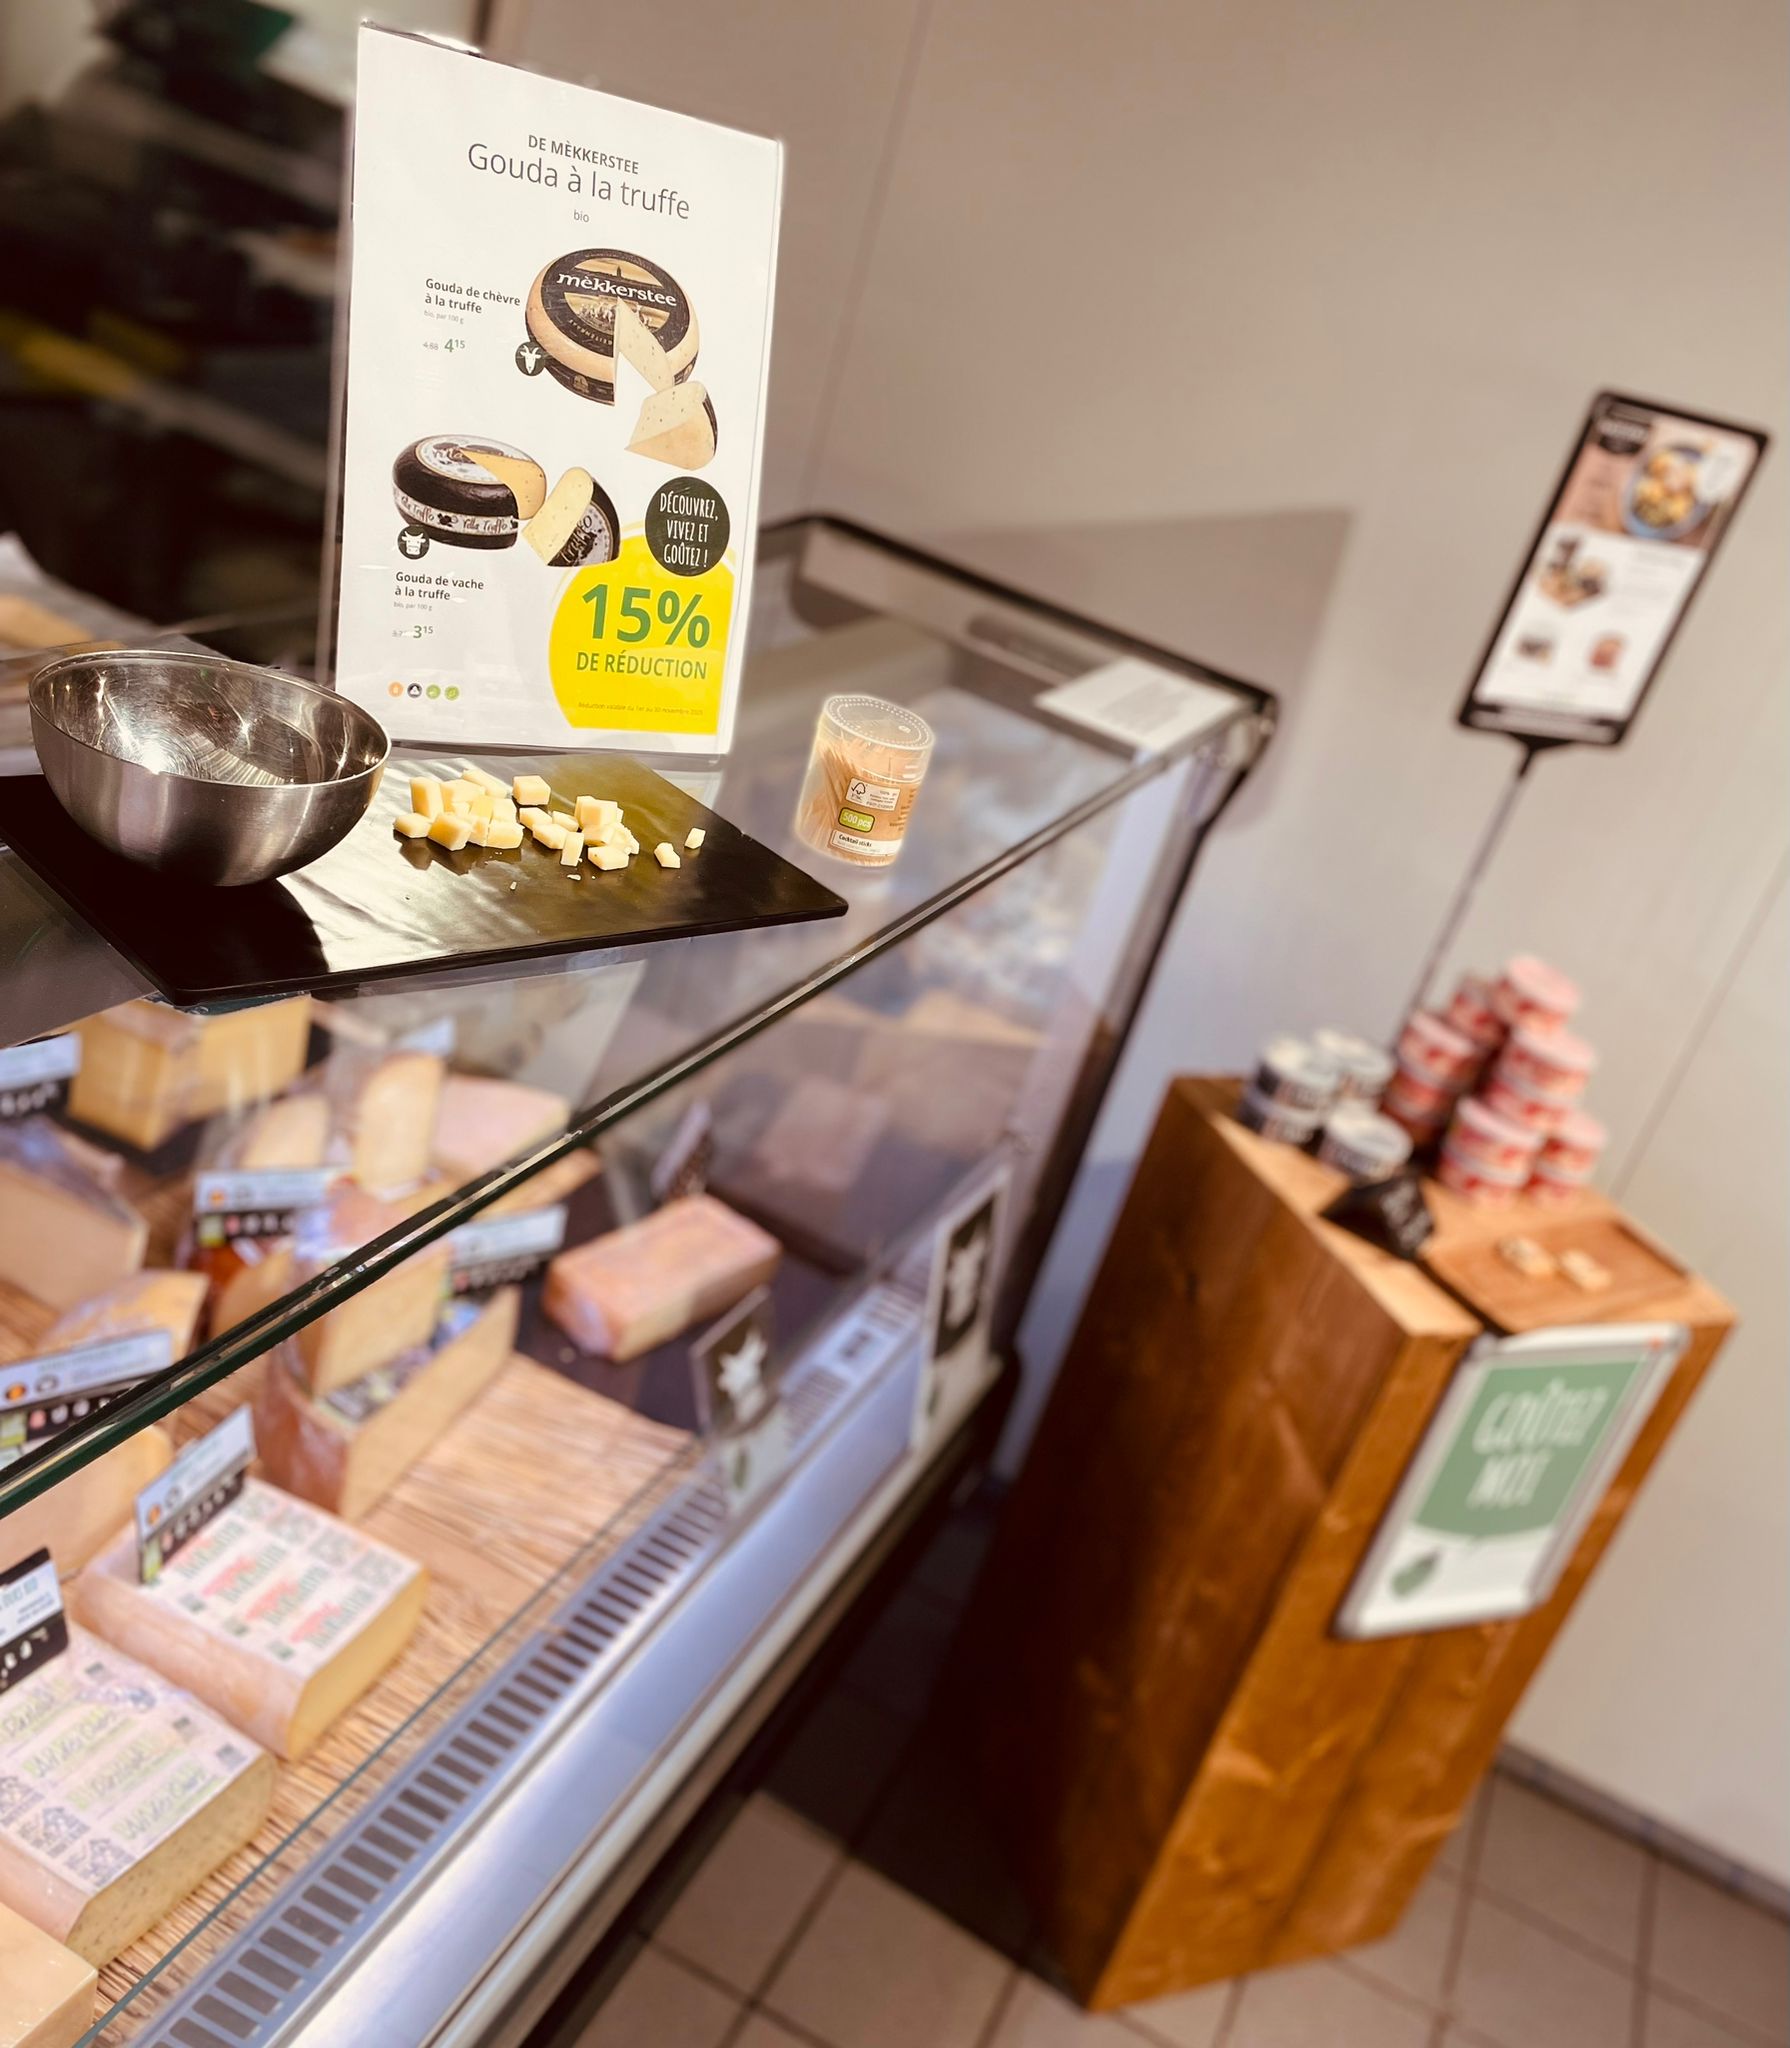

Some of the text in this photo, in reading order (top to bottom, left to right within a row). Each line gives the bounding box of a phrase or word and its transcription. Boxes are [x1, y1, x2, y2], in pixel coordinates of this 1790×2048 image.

[528, 134, 640, 175] DE MÈKKERSTEE
[468, 143, 690, 219] Gouda à la truffe
[574, 210, 590, 223] bio
[425, 278, 521, 306] Gouda de chèvre
[425, 293, 482, 314] à la truffe
[556, 273, 677, 307] mèkkerstee
[660, 490, 719, 522] DÉCOUVREZ,
[666, 519, 709, 543] VIVEZ ET
[663, 541, 708, 568] GOÛTEZ !
[395, 585, 450, 600] à la truffe
[396, 571, 484, 590] Gouda de vache
[582, 583, 711, 650] 15%
[576, 650, 708, 680] DE RÉDUCTION
[843, 811, 858, 824] 500
